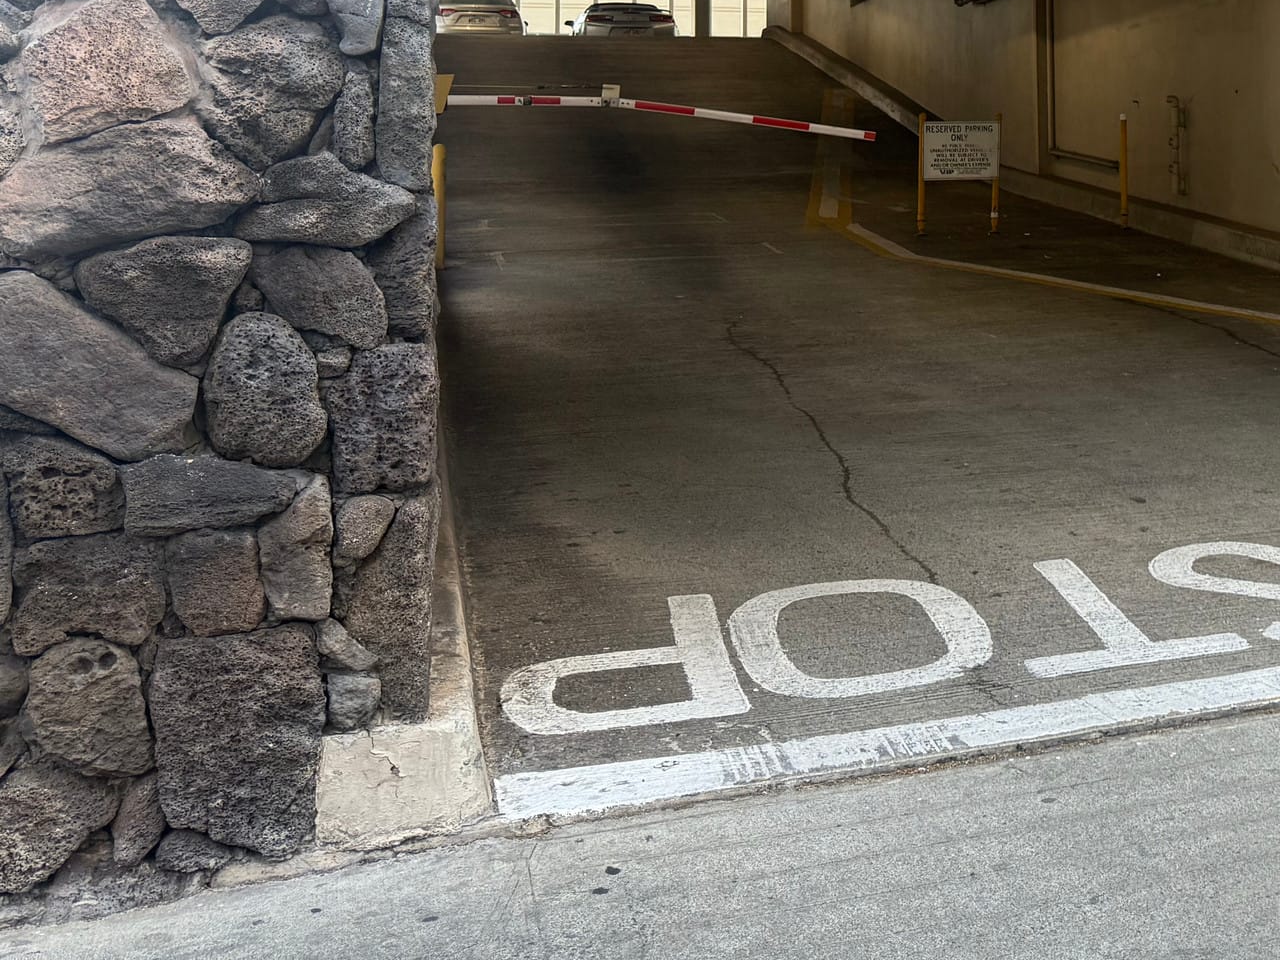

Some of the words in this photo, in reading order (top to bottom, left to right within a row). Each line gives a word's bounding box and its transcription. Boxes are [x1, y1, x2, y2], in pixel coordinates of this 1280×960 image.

[925, 125, 962, 133] RESERVED
[965, 125, 993, 133] PARKING
[950, 133, 968, 142] ONLY
